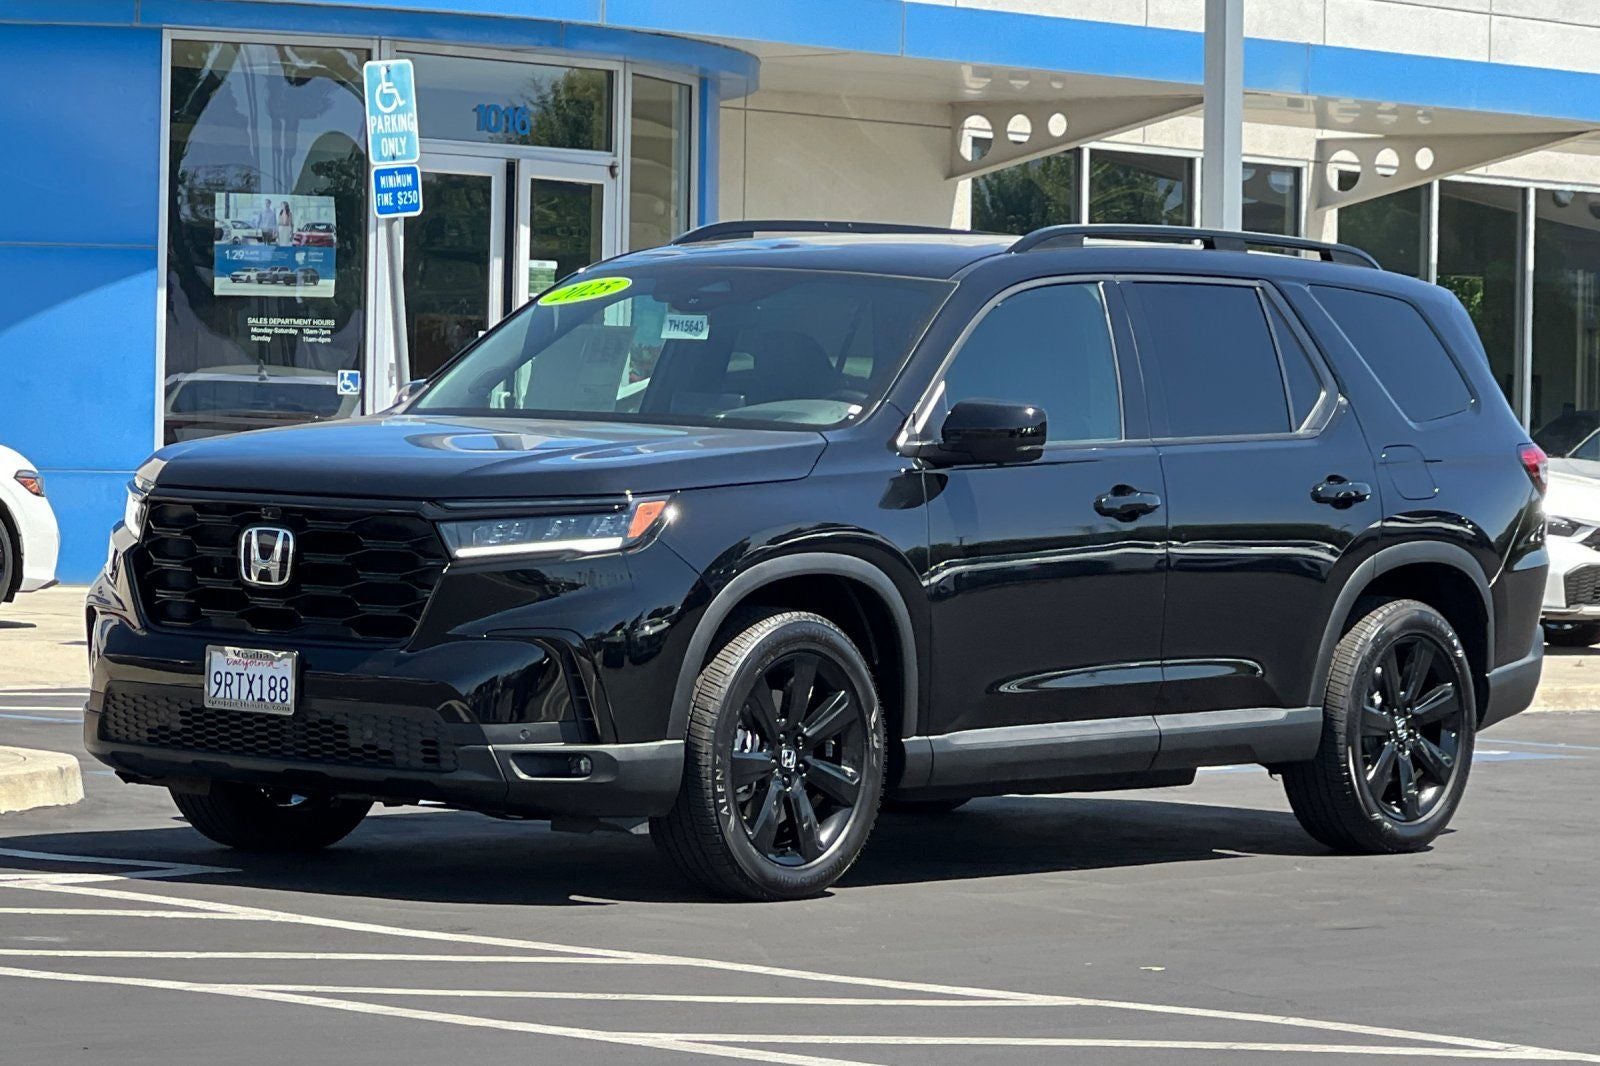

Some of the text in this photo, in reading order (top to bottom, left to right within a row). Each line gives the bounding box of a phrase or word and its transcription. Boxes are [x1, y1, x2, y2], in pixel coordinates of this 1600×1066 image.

[371, 113, 415, 134] PARKING
[472, 103, 531, 135] 1016
[381, 137, 408, 157] ONLY
[380, 173, 412, 188] MINIMUM
[377, 191, 418, 207] FINE $250
[225, 249, 245, 261] 1.29
[268, 317, 312, 325] DEPARTMENT
[668, 319, 704, 333] TH15643
[250, 326, 299, 335] Monday-Saturday
[250, 334, 272, 343] Sunday
[212, 670, 289, 703] 9RTX188
